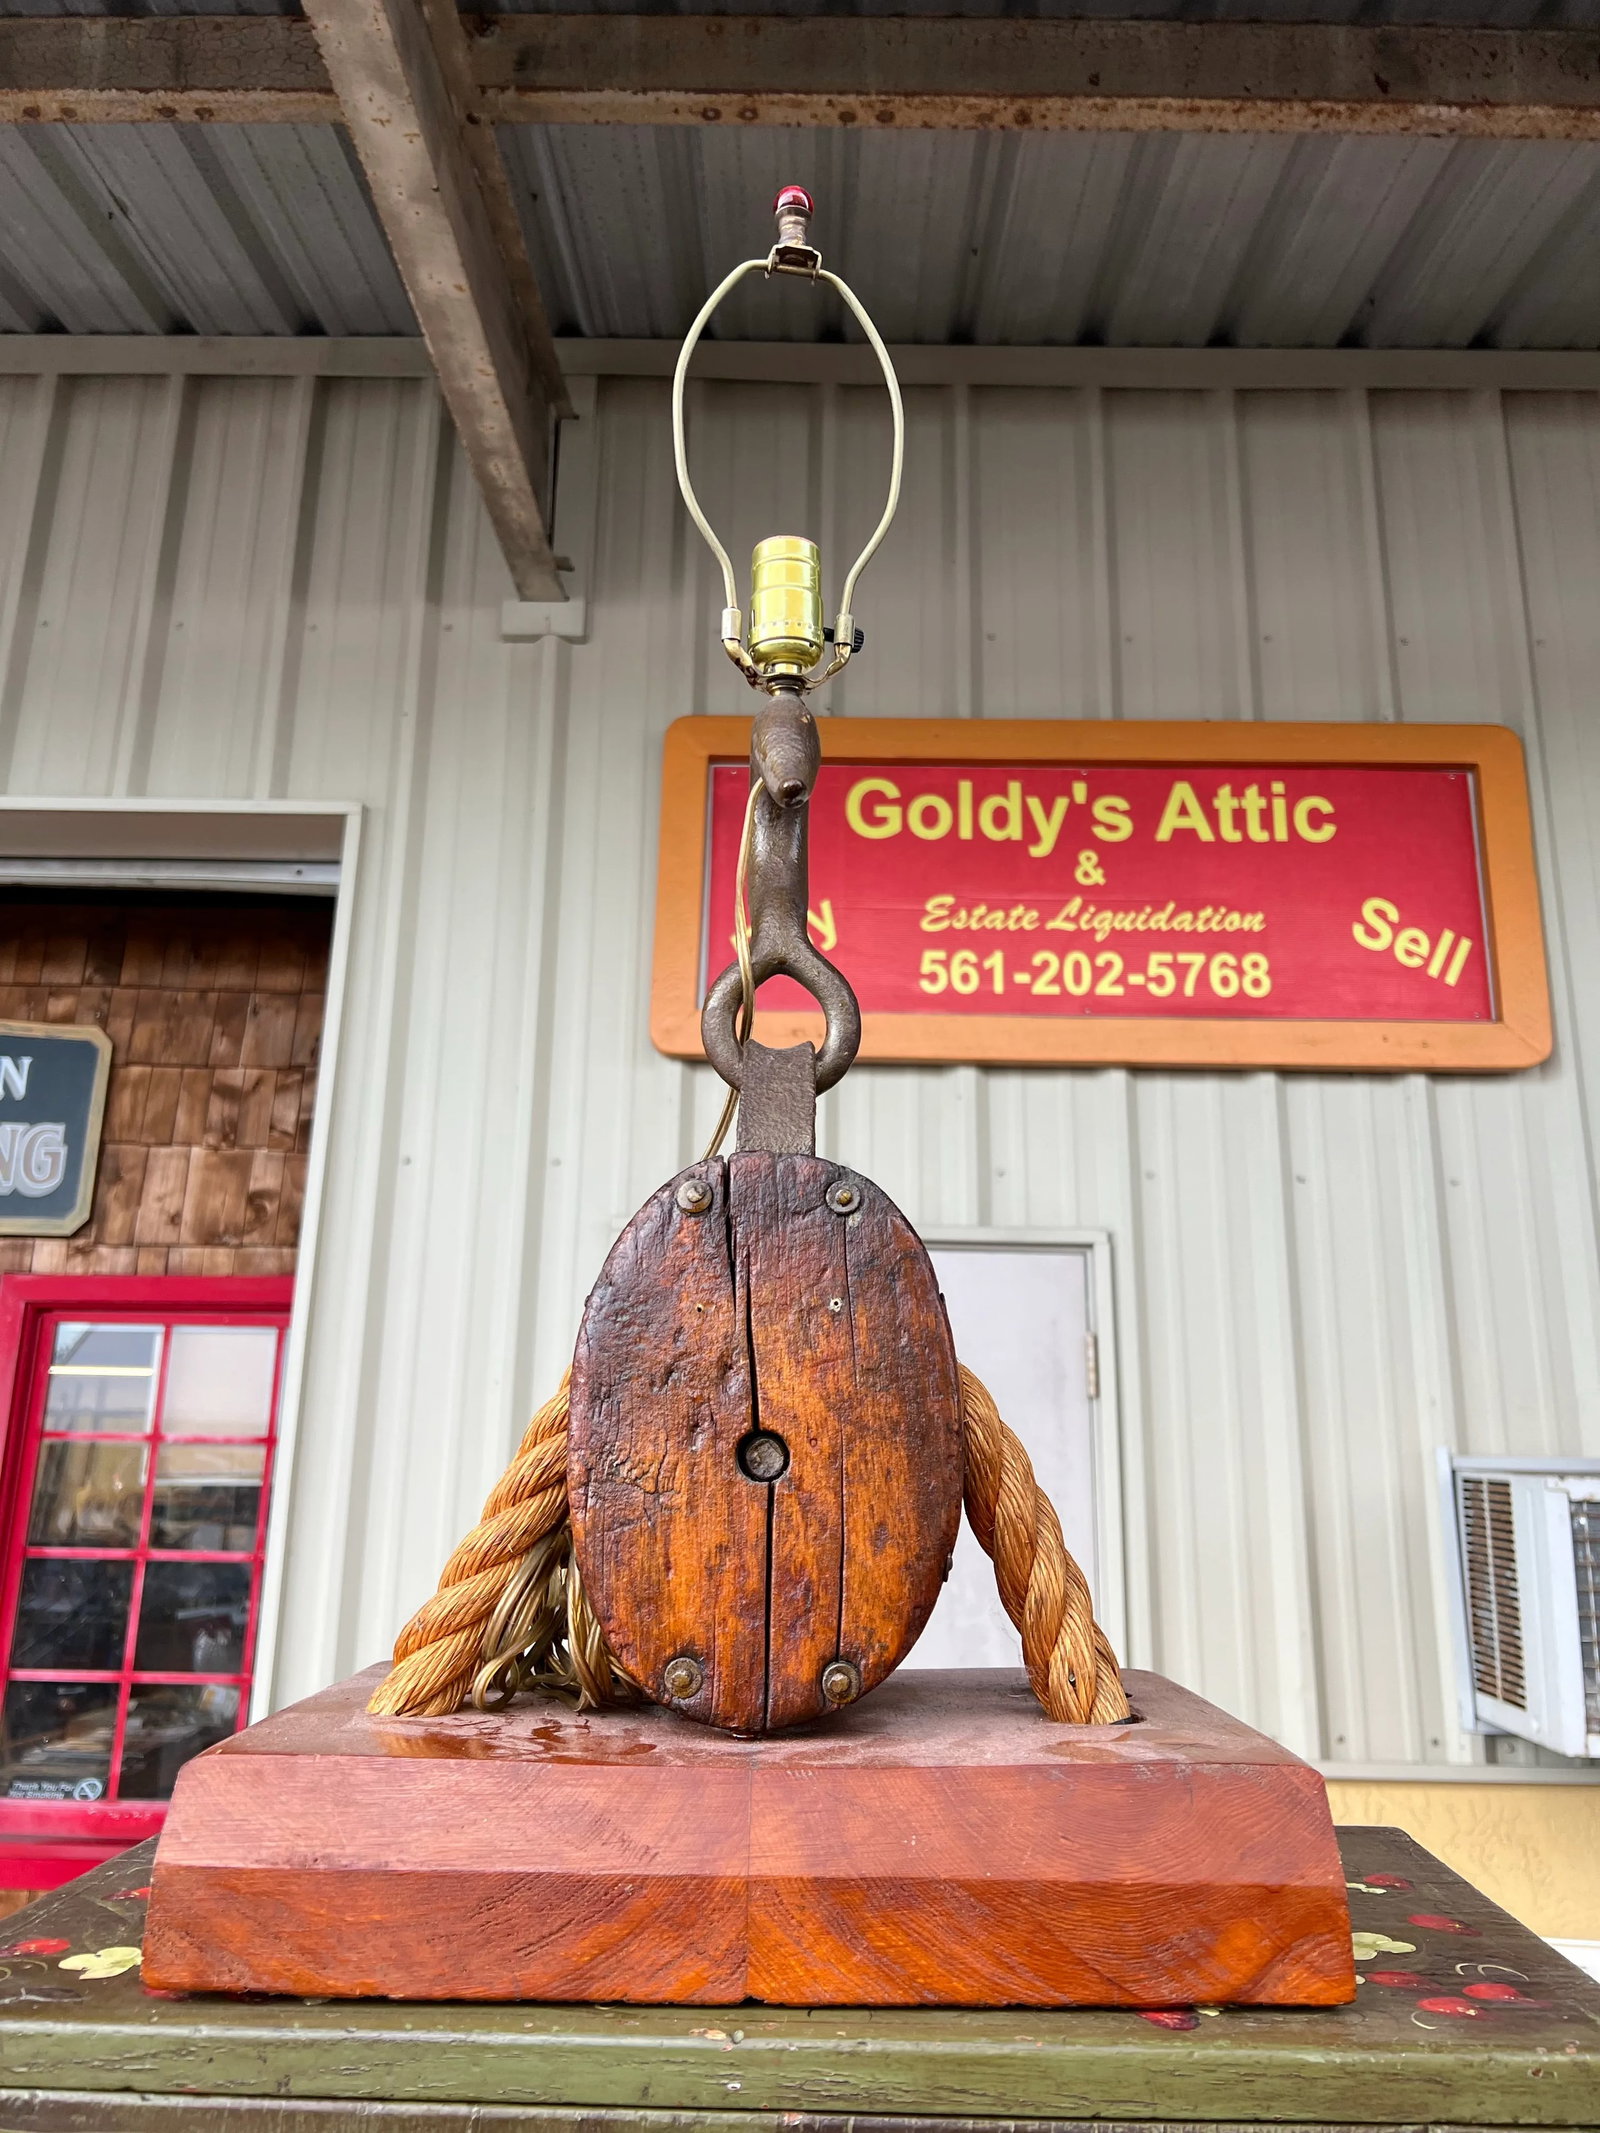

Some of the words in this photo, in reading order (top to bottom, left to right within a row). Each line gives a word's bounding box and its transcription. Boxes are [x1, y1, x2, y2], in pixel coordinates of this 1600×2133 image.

[844, 777, 1134, 858] Goldy's
[1155, 780, 1338, 844] Attic
[1074, 849, 1107, 886] &
[919, 894, 1042, 933] Estate
[1045, 894, 1267, 942] Liquidation
[1351, 897, 1473, 987] Sell
[918, 948, 1273, 998] 561-202-5768
